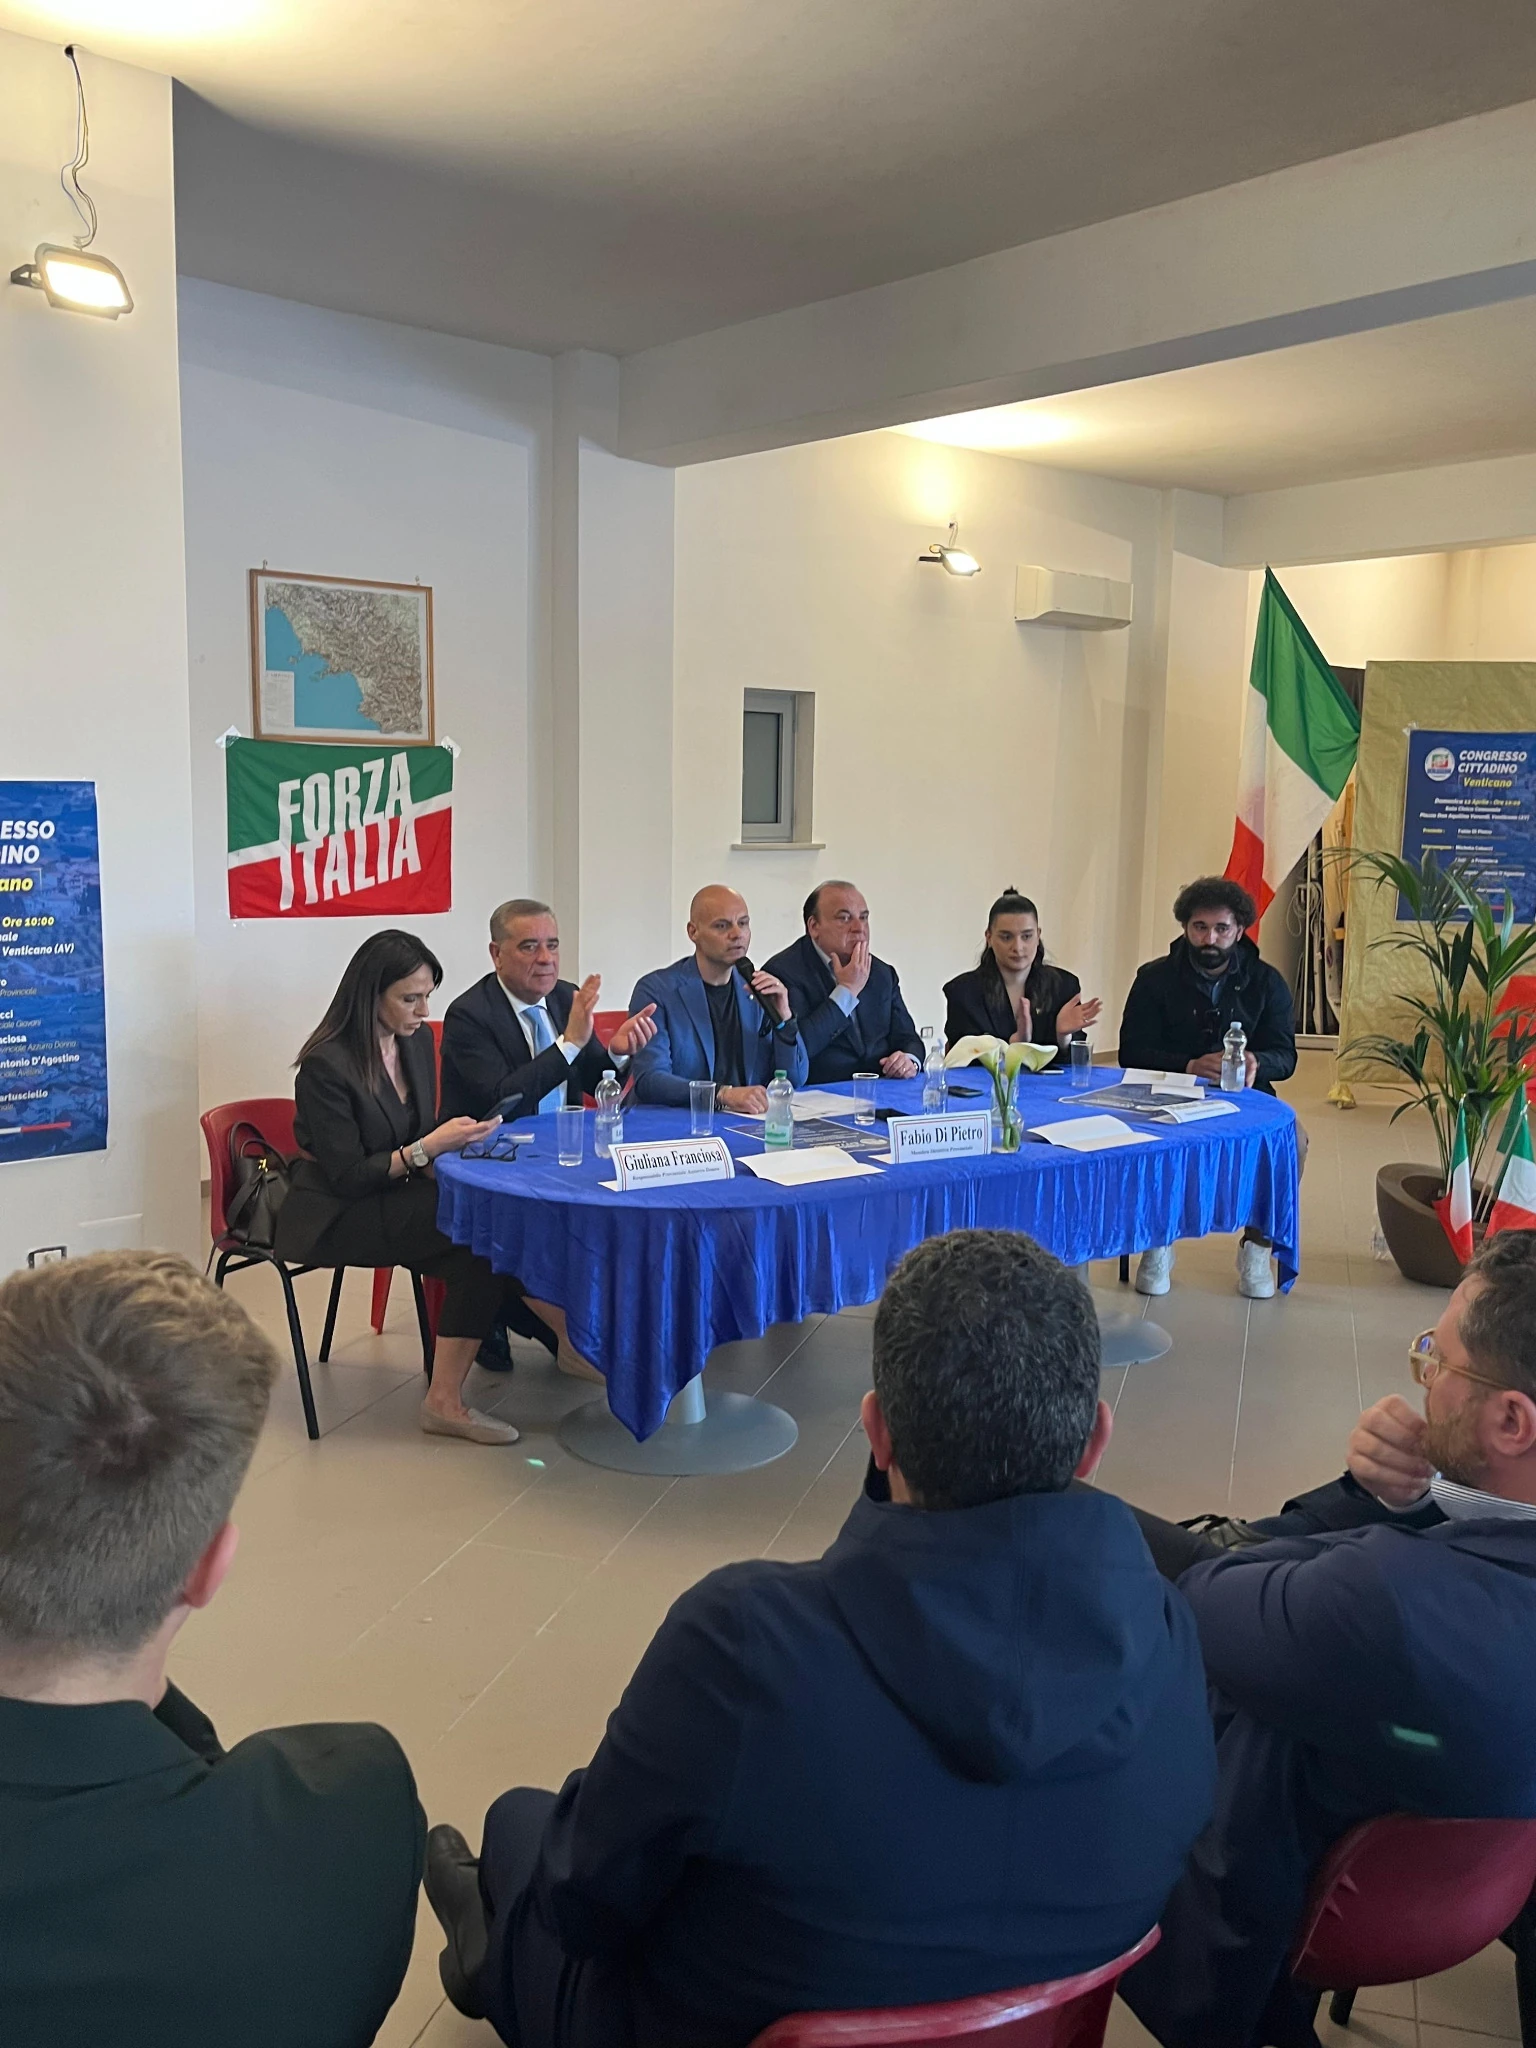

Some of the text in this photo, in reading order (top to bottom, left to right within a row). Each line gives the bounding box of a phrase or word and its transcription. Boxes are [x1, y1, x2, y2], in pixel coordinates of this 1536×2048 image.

[1459, 749, 1527, 762] CONGRESSO
[1457, 762, 1518, 774] CITTADINO
[1463, 777, 1513, 787] Venticano
[278, 752, 413, 845] FORZA
[0, 820, 55, 839] ESSO
[0, 845, 40, 864] INO
[279, 815, 421, 911] ITALIA
[2, 916, 55, 927] Ore 10:00
[2, 943, 75, 957] Venticano (AV)
[31, 1053, 80, 1067] D'Agostino
[900, 1126, 983, 1146] Fabio Di Pietro
[624, 1148, 723, 1172] Giuliana Franciosa
